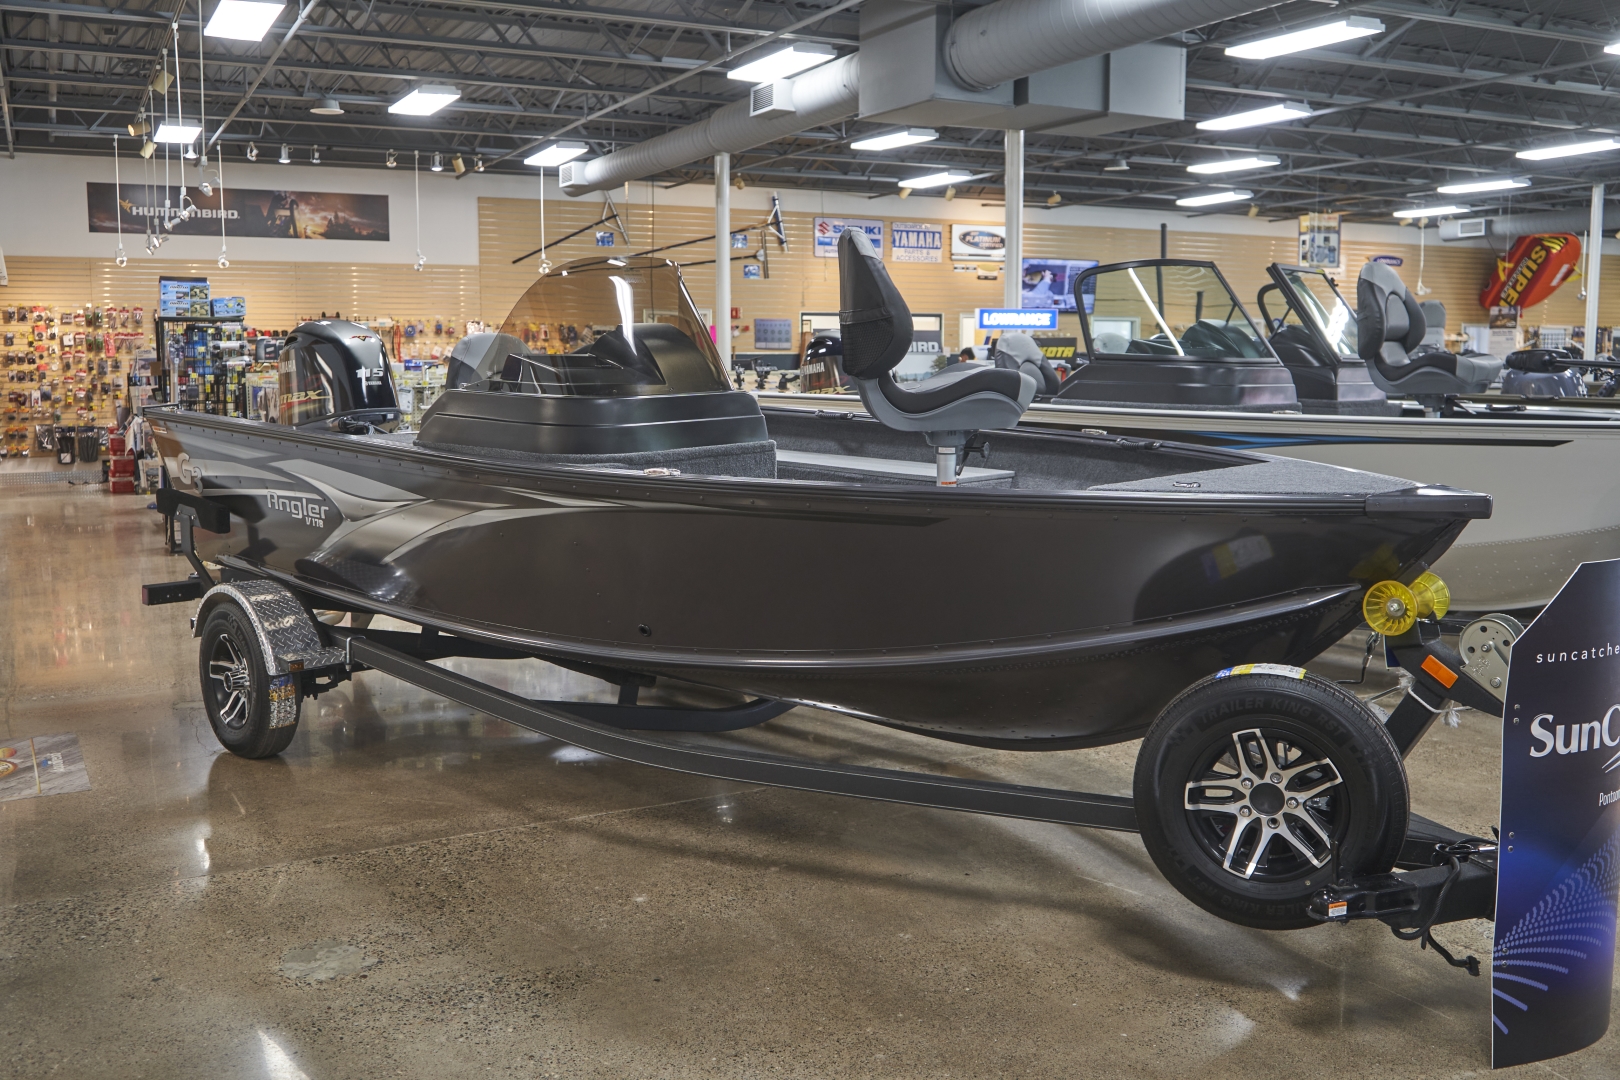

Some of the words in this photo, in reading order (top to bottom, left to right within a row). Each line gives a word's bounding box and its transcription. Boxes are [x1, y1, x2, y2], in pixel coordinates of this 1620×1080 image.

[132, 206, 239, 219] HUMMNBIRD
[832, 225, 881, 235] SUKI
[893, 231, 941, 248] YAMAHA
[965, 235, 1001, 243] PLATINUM
[982, 312, 1052, 326] LOWRANCE
[355, 367, 384, 378] 115
[804, 362, 825, 375] YAMAHA
[177, 452, 203, 494] G3
[266, 490, 330, 519] Angler
[1200, 698, 1265, 724] TRAILER
[1270, 699, 1312, 717] KING
[1317, 714, 1347, 736] RST
[1188, 875, 1218, 897] RST
[1220, 894, 1260, 914] KING
